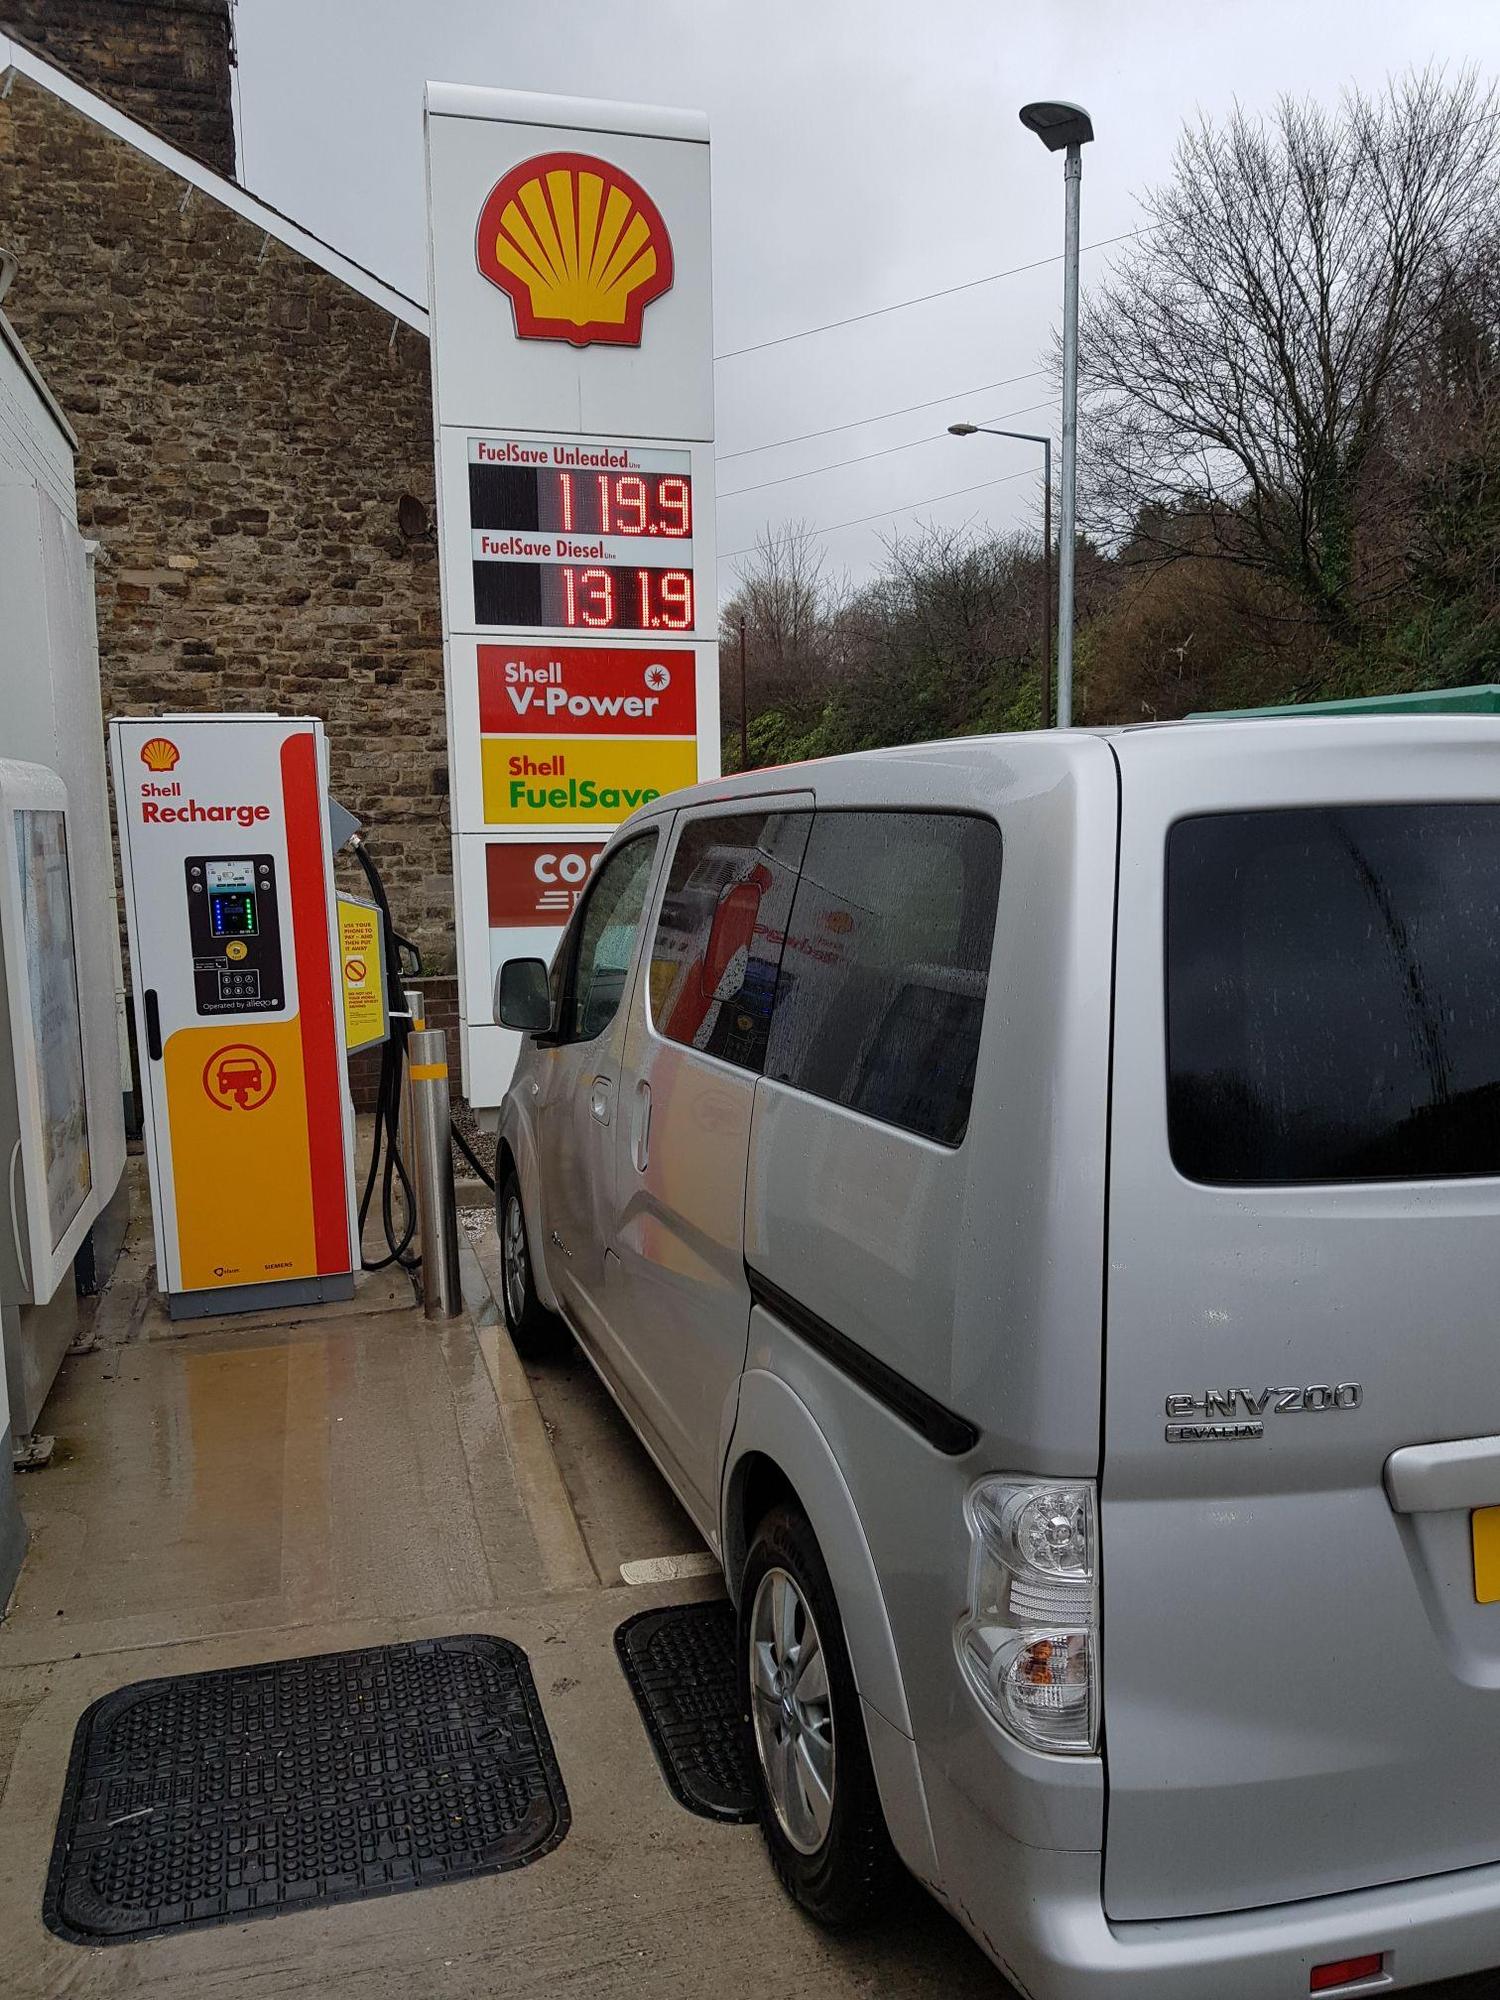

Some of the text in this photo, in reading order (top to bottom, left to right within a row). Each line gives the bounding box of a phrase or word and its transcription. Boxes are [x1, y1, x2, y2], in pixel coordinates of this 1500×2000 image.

[478, 442, 548, 464] FuelSave
[553, 446, 628, 469] Unleaded
[482, 536, 552, 557] FuelSave
[556, 540, 604, 559] Diesel
[504, 661, 562, 683] Shell
[506, 686, 660, 718] V-Power
[508, 755, 566, 777] Shell
[141, 782, 181, 797] Shell
[509, 778, 660, 809] FuelSave
[142, 799, 271, 828] Recharge
[203, 1002, 235, 1011] Operated
[246, 999, 272, 1008] allego
[264, 1262, 293, 1271] SIEMENS
[1166, 1382, 1364, 1417] e-NV200
[1180, 1425, 1254, 1440] EVALIA
